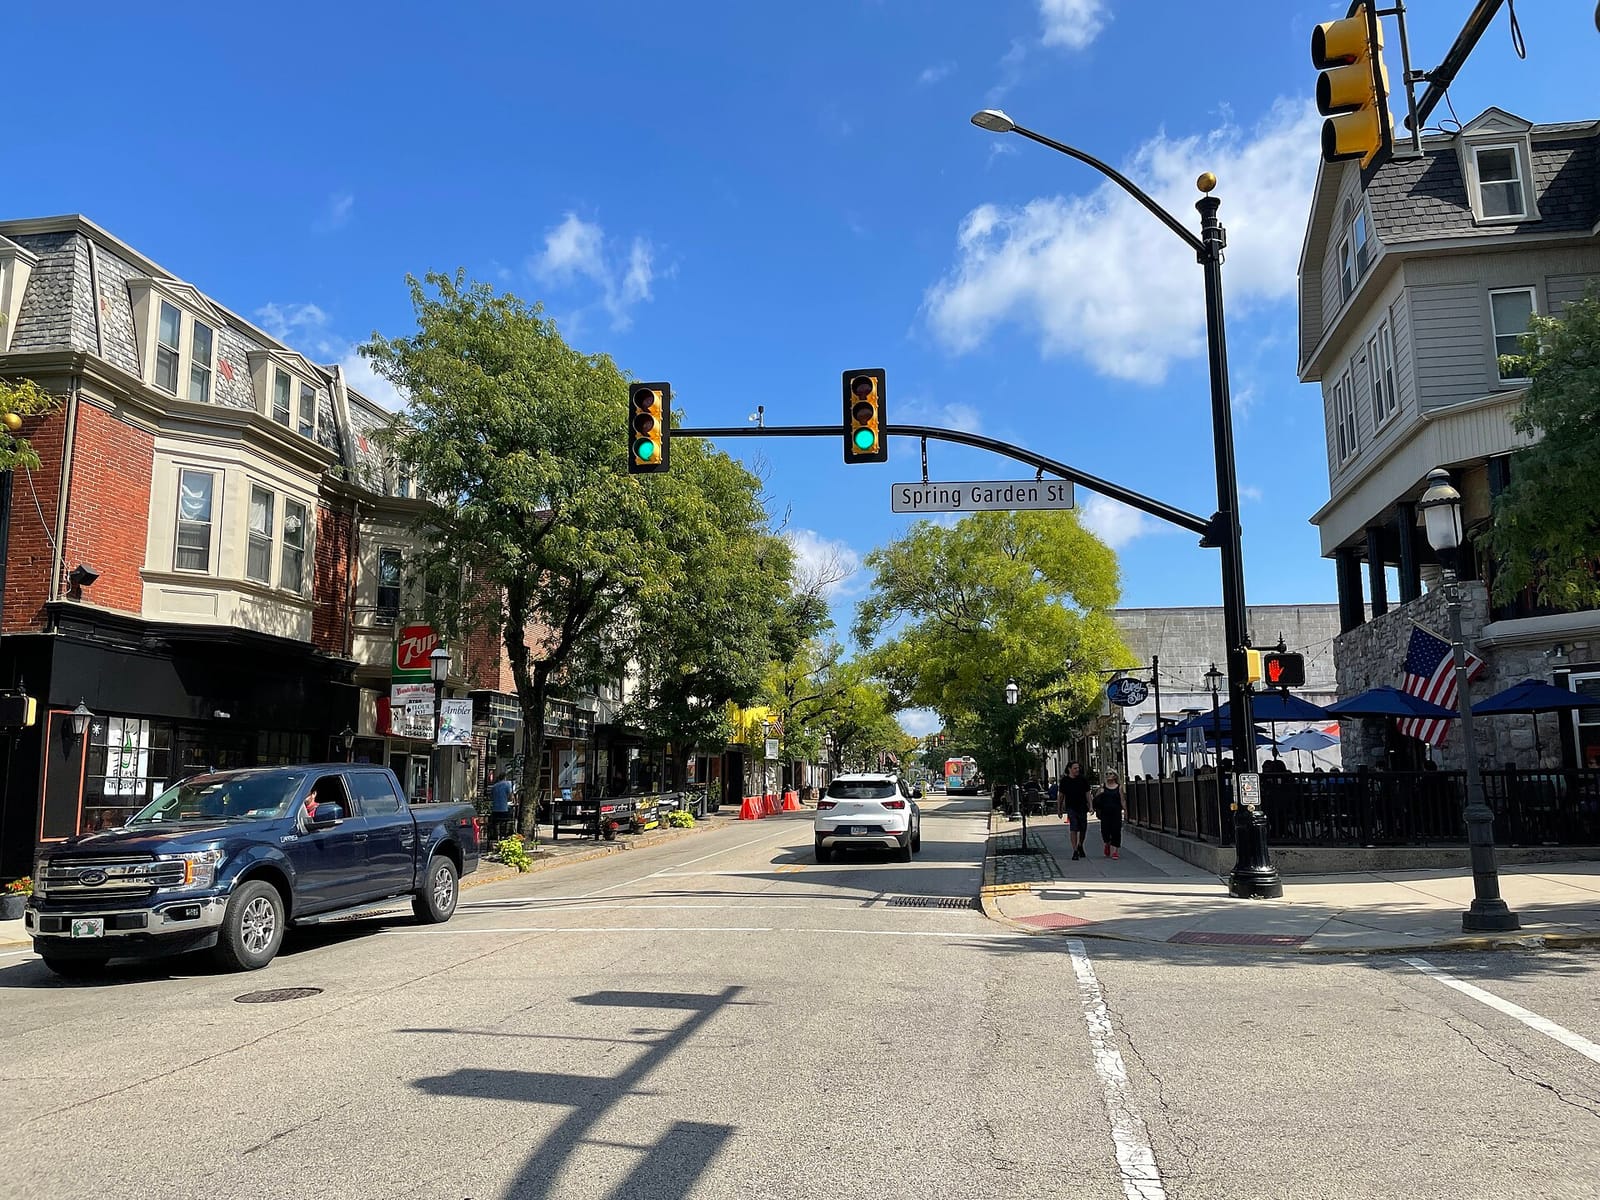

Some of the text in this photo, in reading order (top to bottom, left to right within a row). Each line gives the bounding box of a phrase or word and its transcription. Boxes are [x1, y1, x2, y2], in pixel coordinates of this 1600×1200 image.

[902, 484, 1065, 508] Spring Garden St
[441, 705, 471, 715] Ambler
